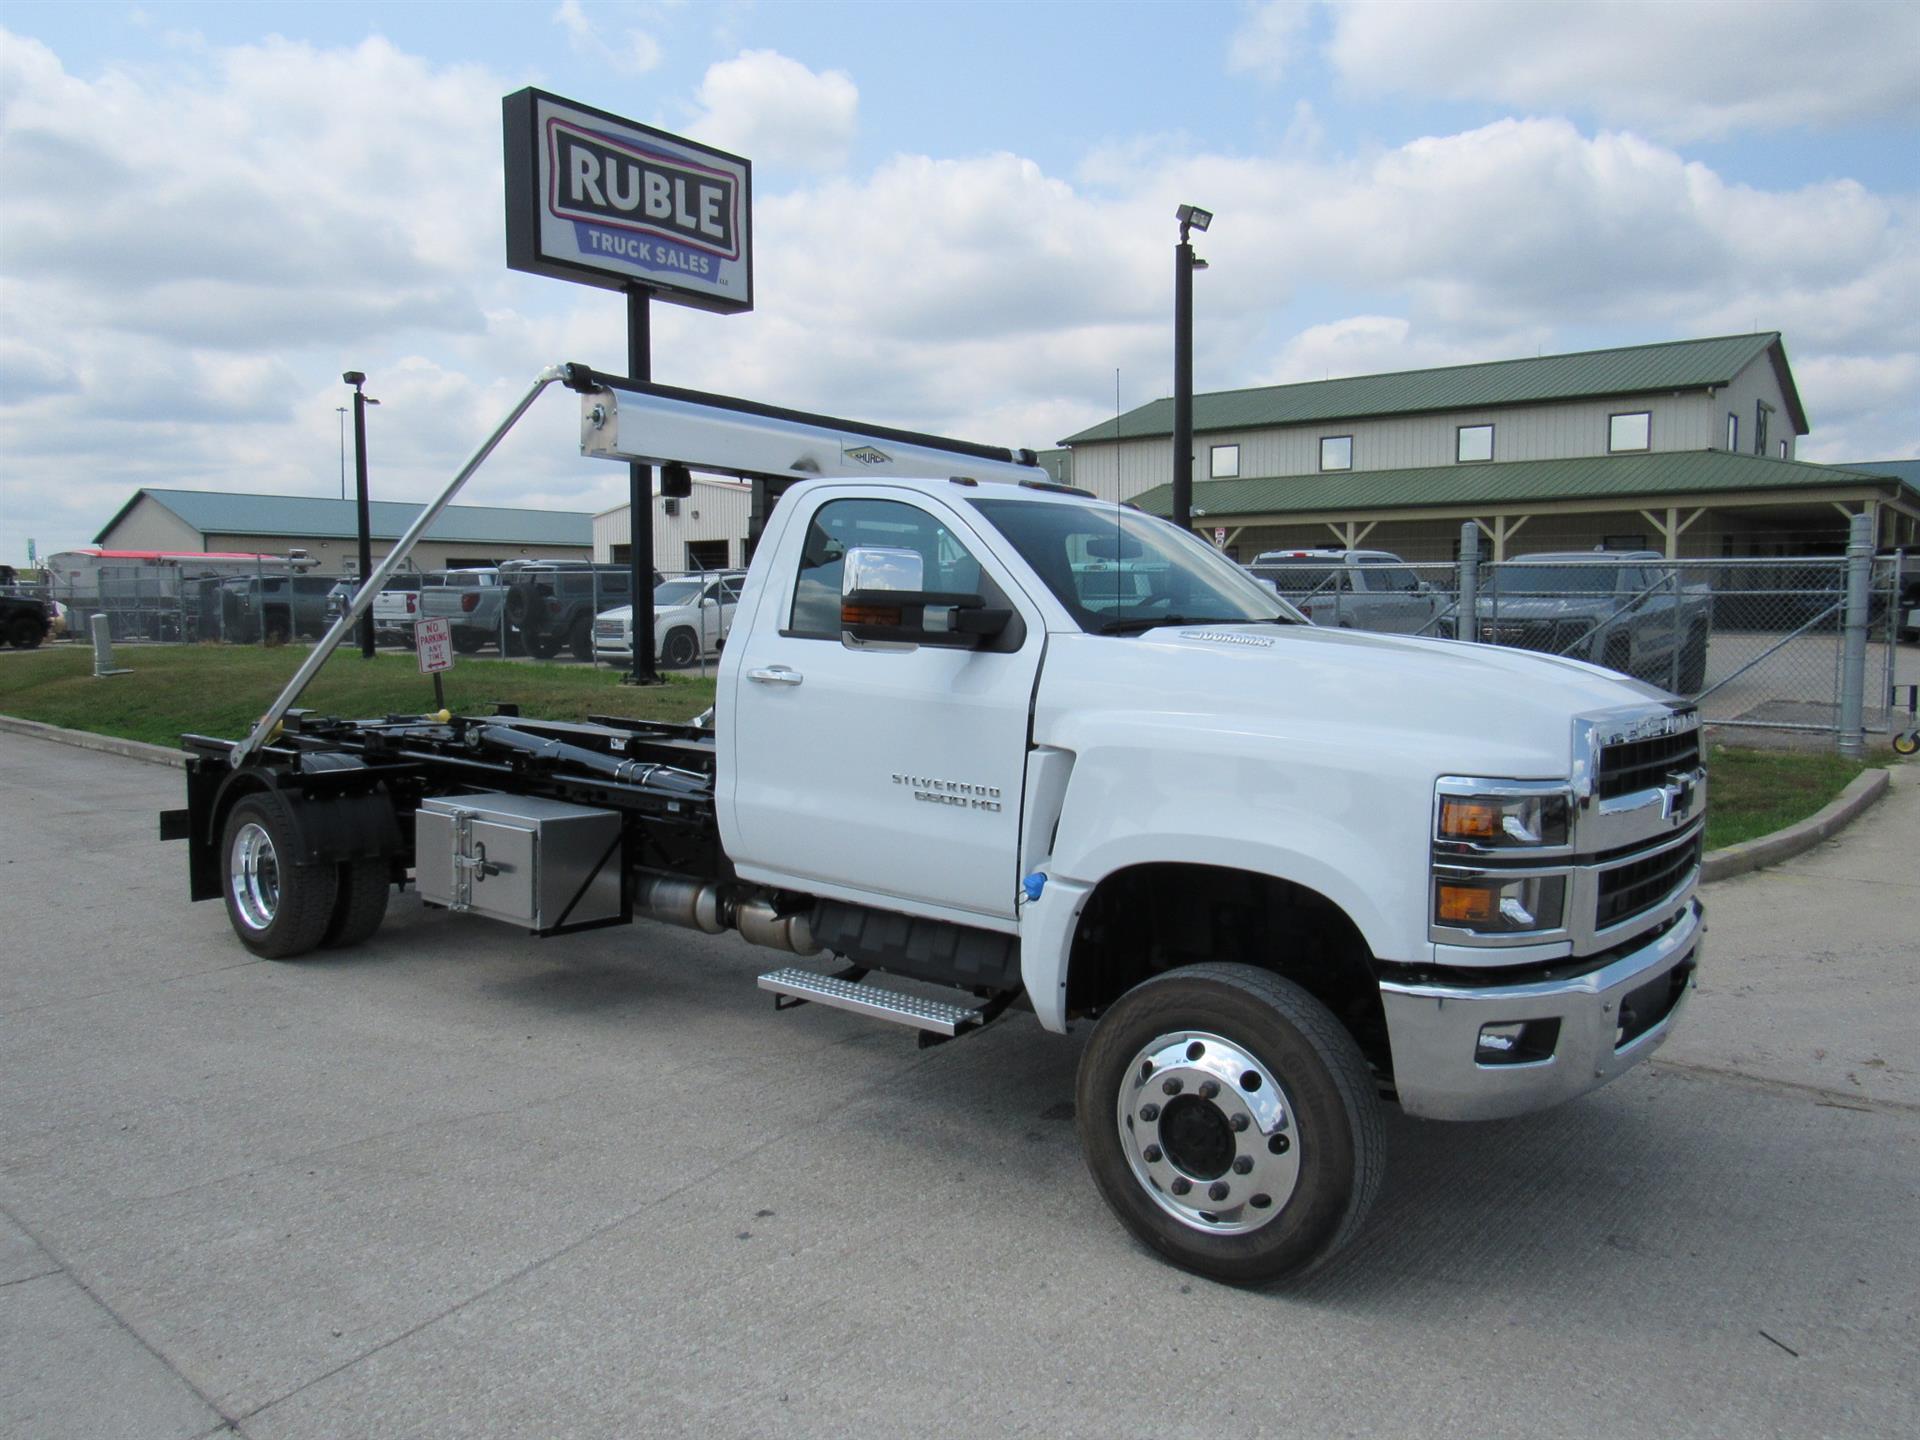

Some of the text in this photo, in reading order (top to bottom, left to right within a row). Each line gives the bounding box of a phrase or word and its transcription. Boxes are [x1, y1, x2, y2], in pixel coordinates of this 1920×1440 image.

[570, 144, 723, 239] RUBLE
[589, 230, 709, 274] TRUCK SALES
[426, 623, 438, 633] NO
[420, 632, 447, 645] PARKING
[892, 772, 1001, 798] SILVERADO
[972, 799, 1001, 812] HD
